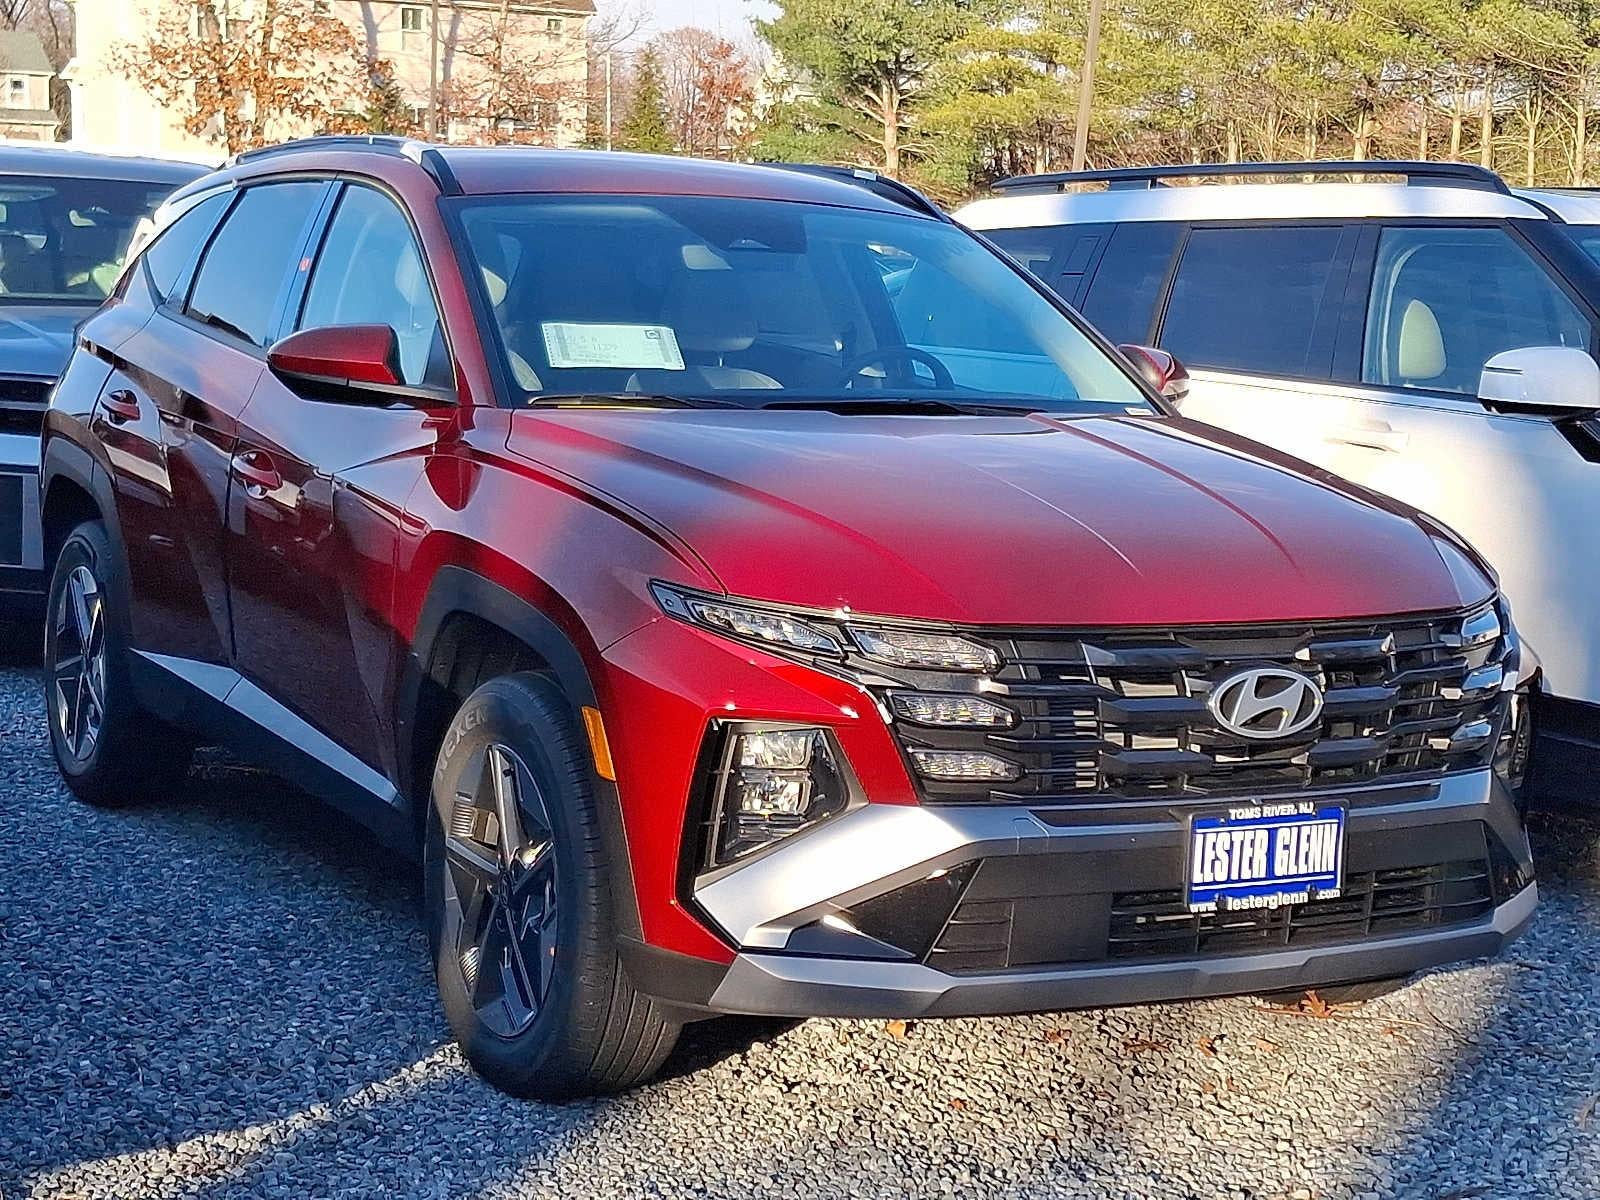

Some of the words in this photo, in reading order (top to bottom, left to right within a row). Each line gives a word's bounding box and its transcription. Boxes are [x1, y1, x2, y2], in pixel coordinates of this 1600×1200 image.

[1229, 806, 1262, 820] TOMS
[1193, 829, 1269, 884] LESTER
[1274, 825, 1338, 877] GLENN
[1228, 891, 1309, 911] lesterglenn
